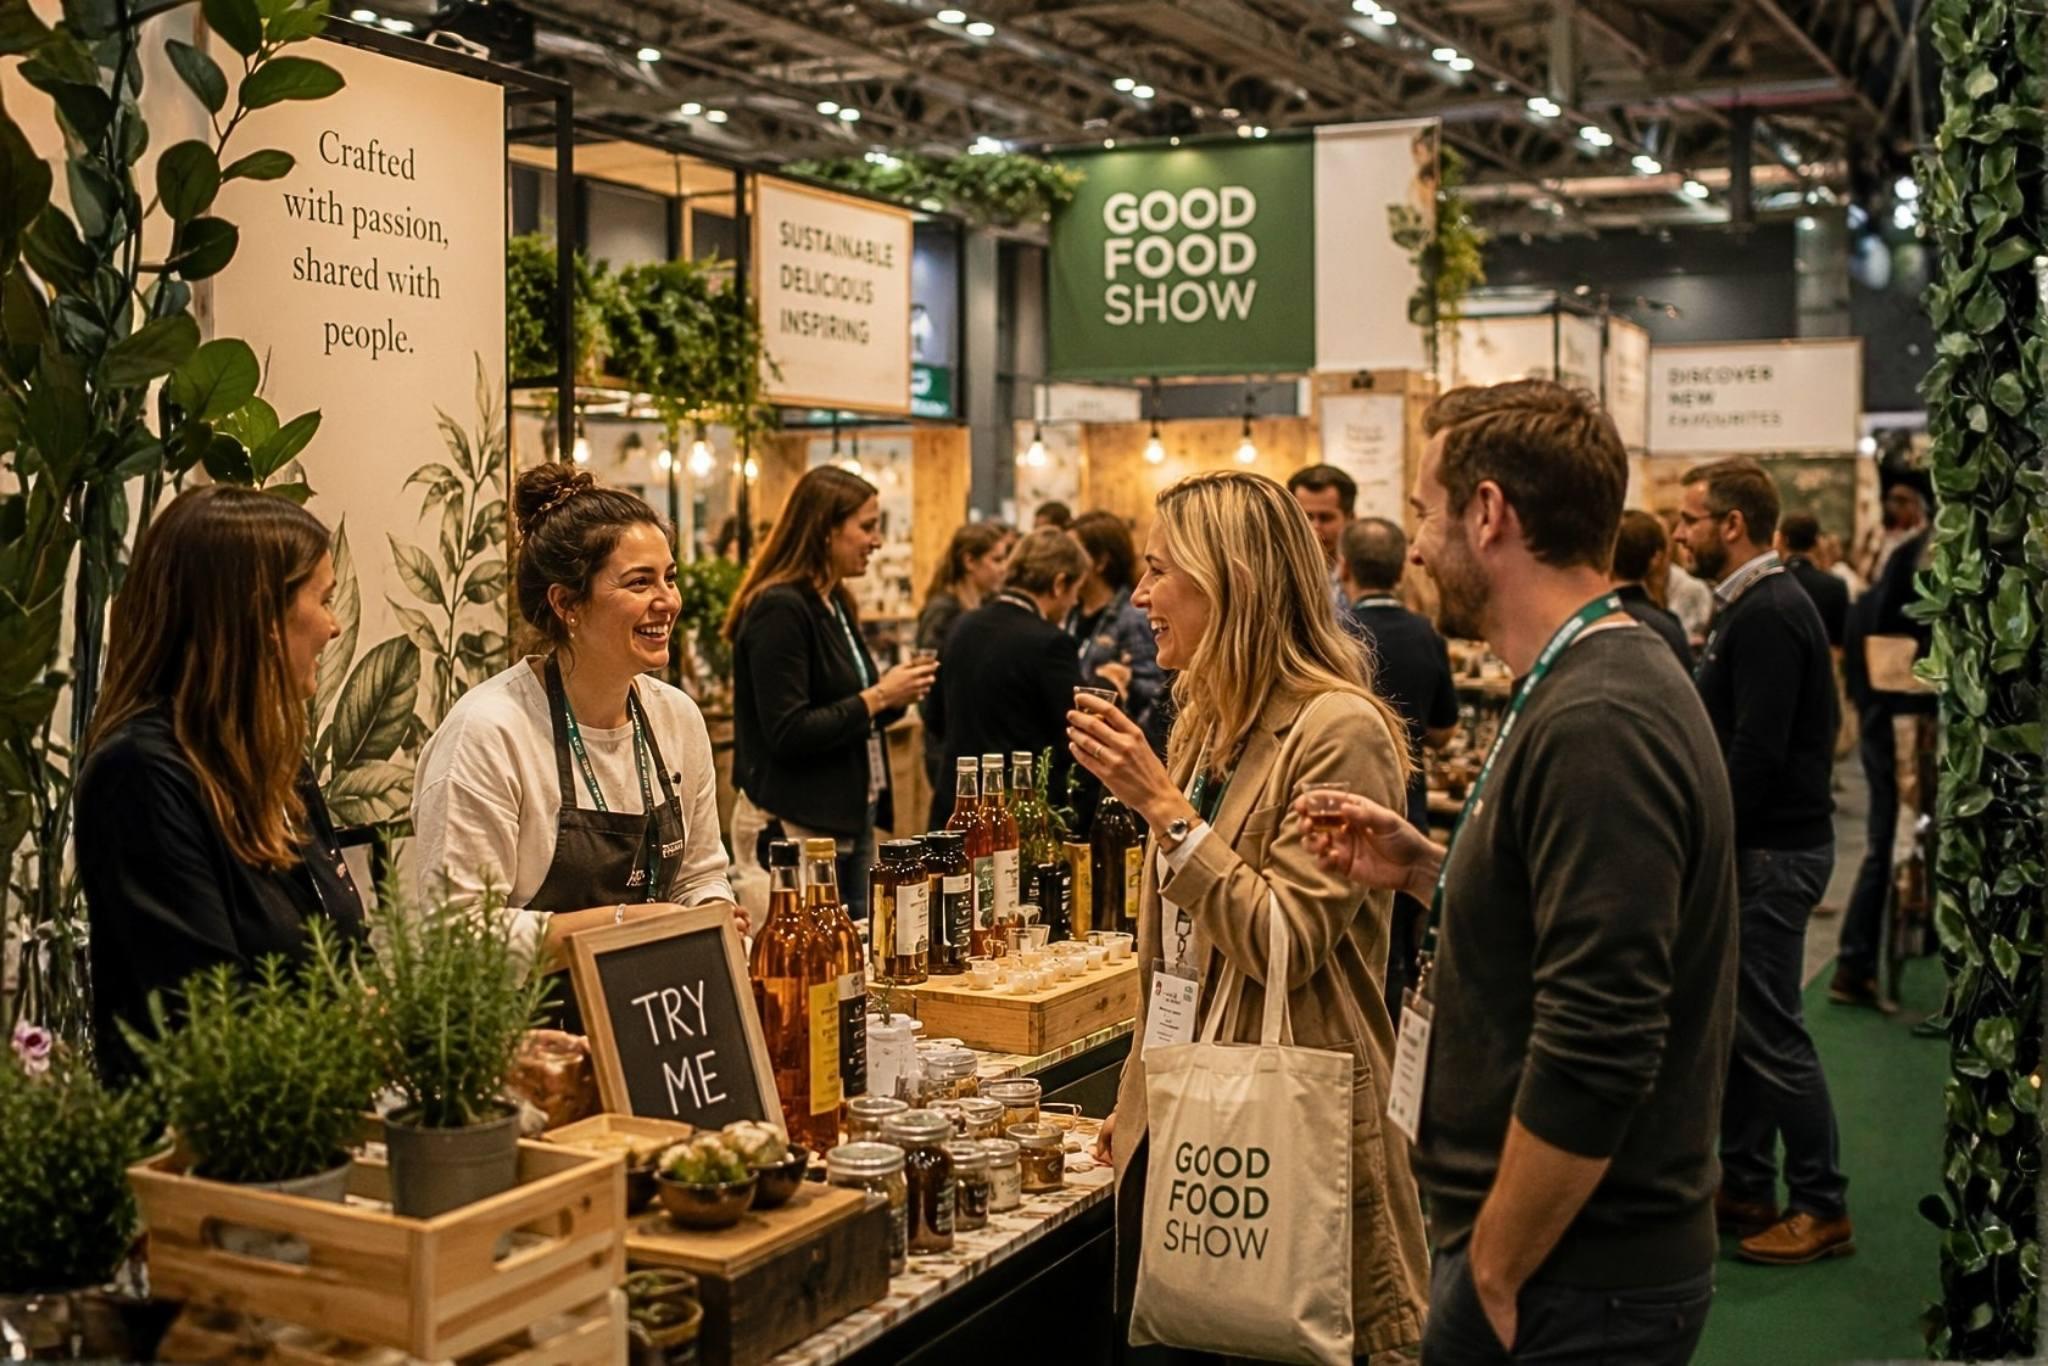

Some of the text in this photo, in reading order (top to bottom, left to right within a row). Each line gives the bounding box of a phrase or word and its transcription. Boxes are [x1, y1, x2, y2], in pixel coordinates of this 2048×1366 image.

[318, 130, 416, 181] Crafted
[283, 187, 449, 250] with passion,
[1103, 186, 1257, 235] GOOD
[779, 220, 895, 269] SUSTAINABLE
[1103, 231, 1257, 281] FOOD
[292, 246, 441, 299] shared with
[780, 264, 874, 305] DELICIOUS
[1103, 278, 1257, 326] SHOW
[323, 318, 415, 361] people.
[780, 309, 870, 345] INSPIRING
[1667, 365, 1774, 386] DISCOVER
[631, 979, 707, 1046] TRY
[663, 1050, 727, 1115] ME
[1175, 1141, 1270, 1179] GOOD
[1168, 1179, 1270, 1220] FOOD
[1163, 1218, 1269, 1260] SHOW
